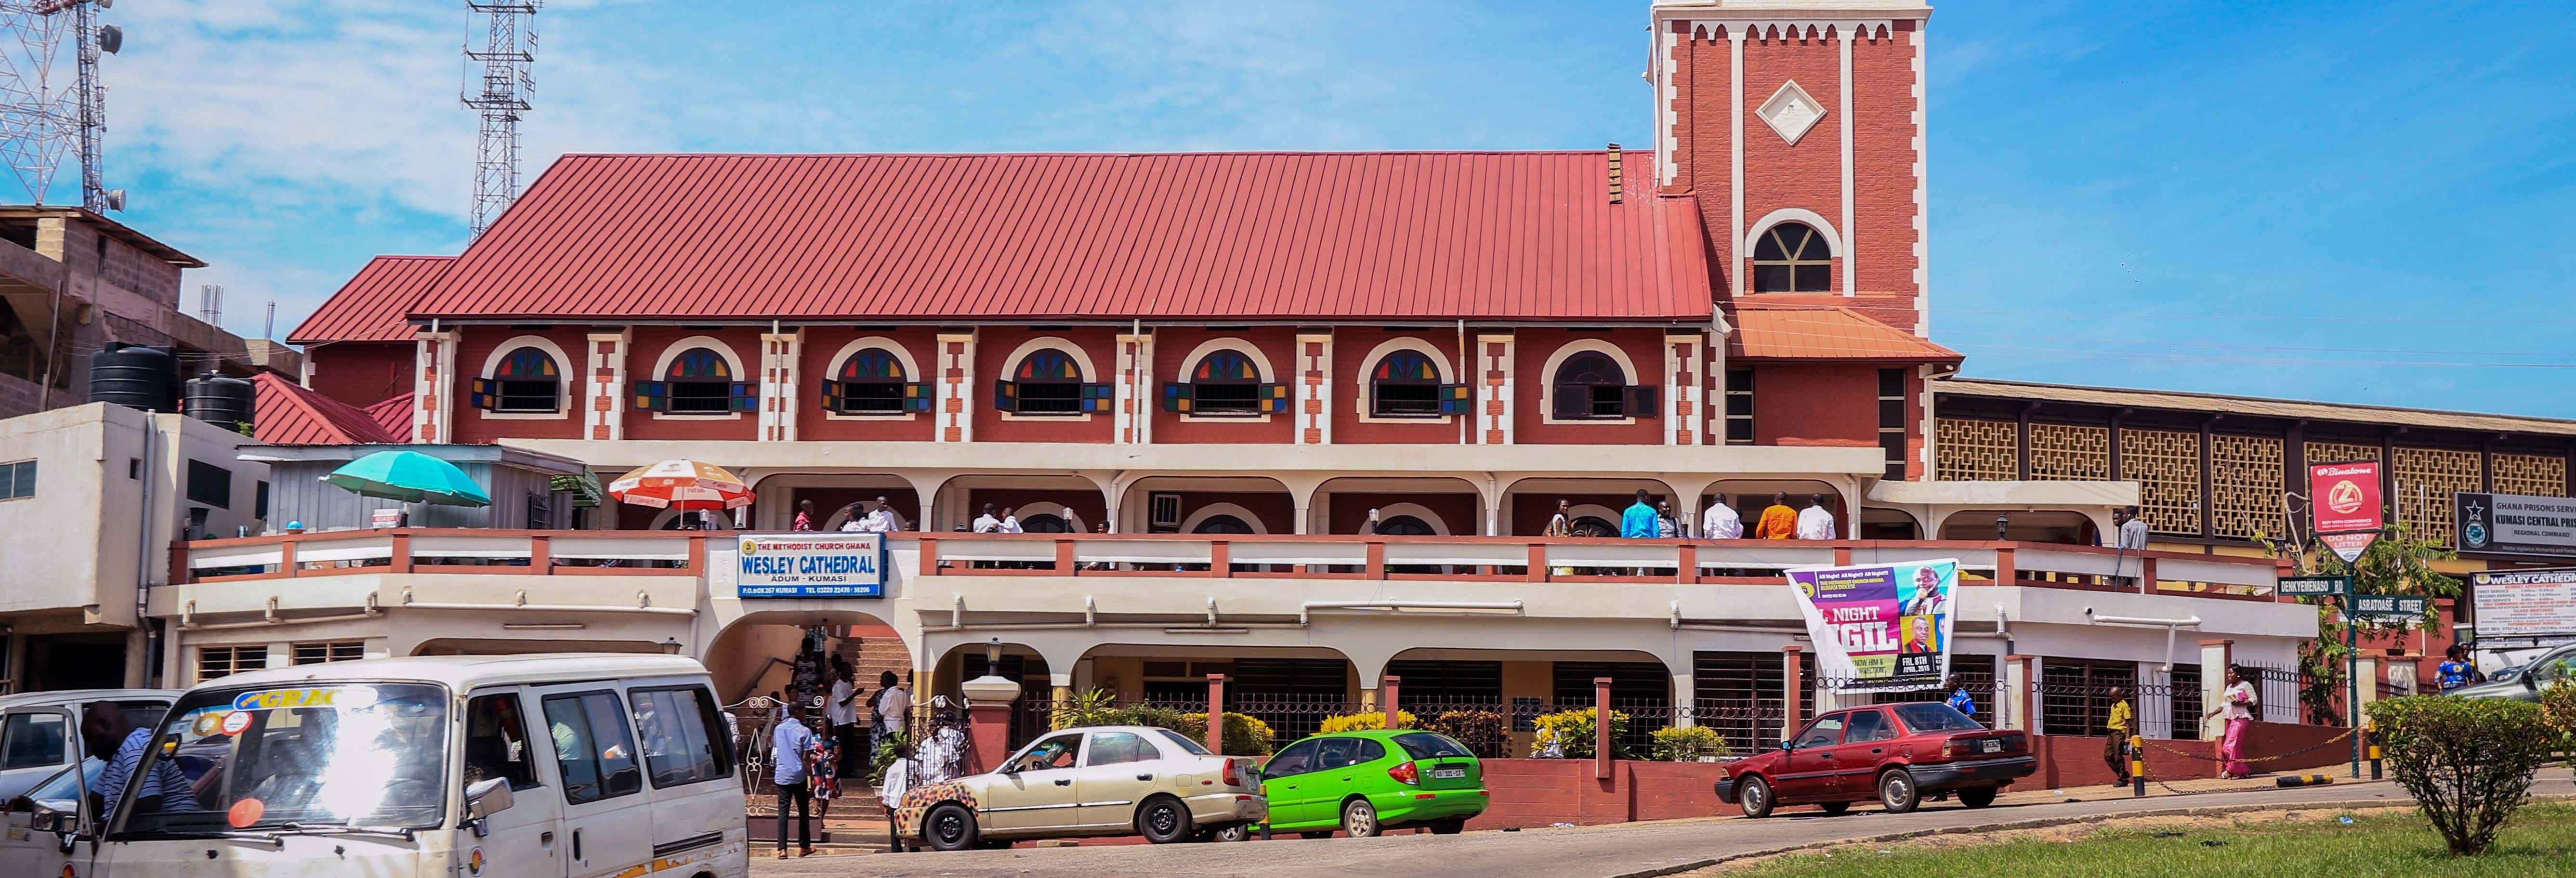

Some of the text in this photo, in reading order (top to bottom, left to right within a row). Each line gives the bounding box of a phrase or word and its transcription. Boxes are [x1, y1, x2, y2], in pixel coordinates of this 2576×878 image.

[2327, 467, 2372, 476] Binatone
[2338, 484, 2353, 503] 2
[2497, 502, 2523, 511] GHANA
[2496, 514, 2525, 525] KUMASI
[2527, 516, 2559, 527] CENTRAL
[742, 555, 876, 574] WESLEY CATHEDRAL
[2281, 580, 2343, 592] DENKYEMENASO RD
[2358, 599, 2422, 611] ASRATOASE STREET
[1833, 606, 1880, 622] NIGHT
[1915, 656, 1927, 665] 8TH
